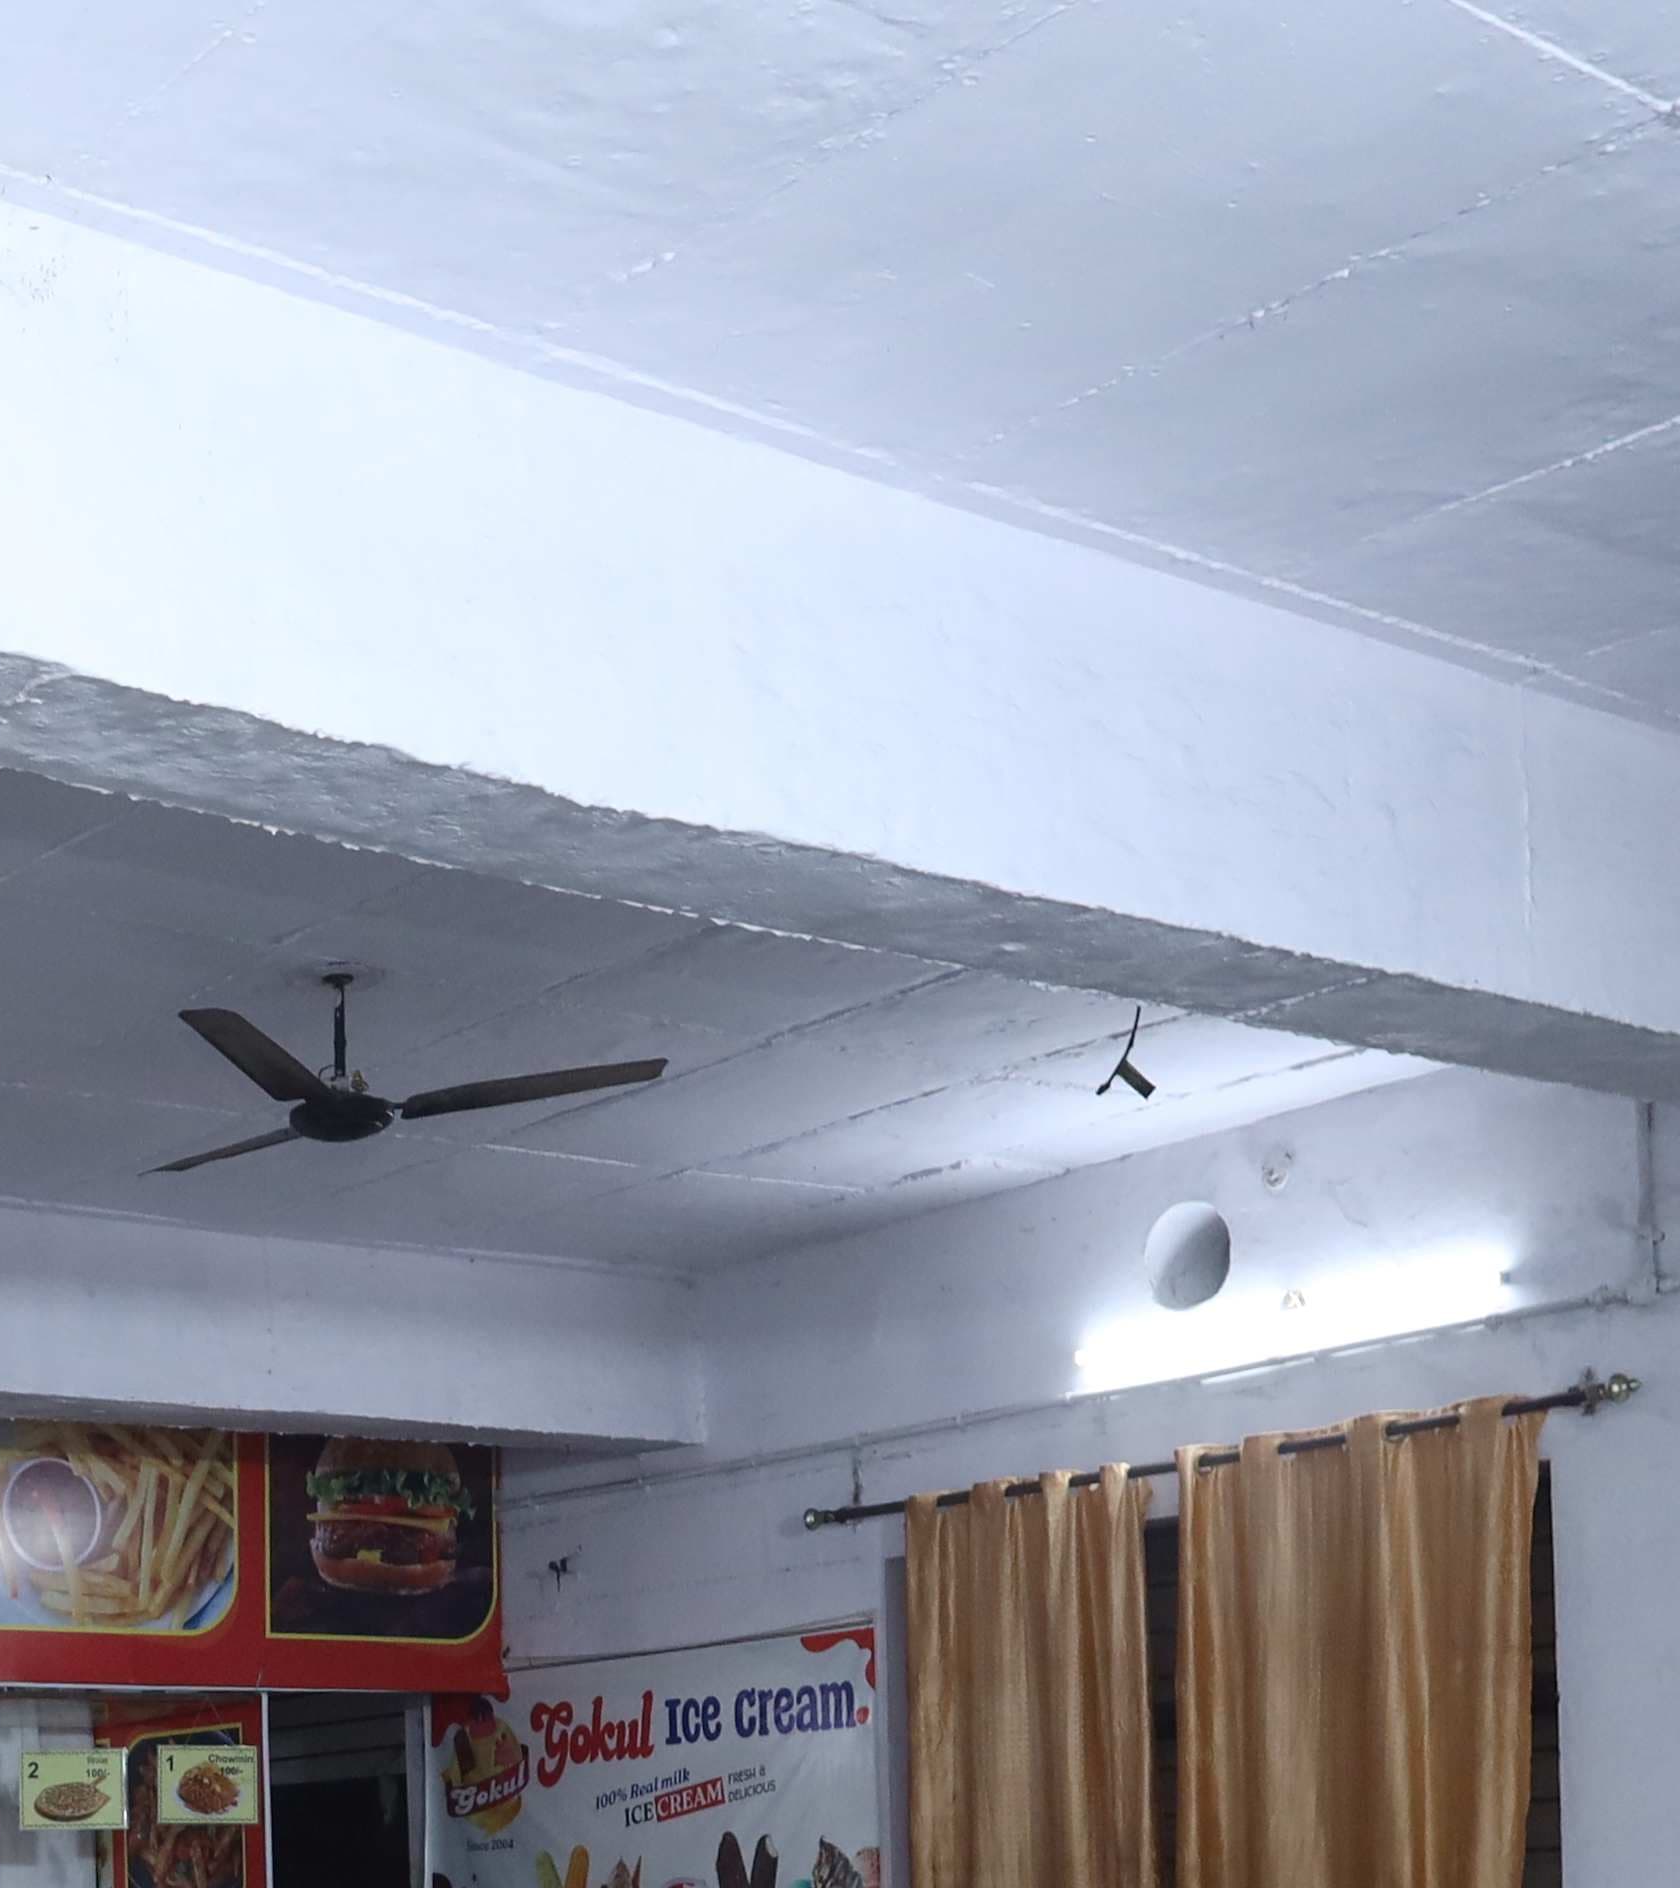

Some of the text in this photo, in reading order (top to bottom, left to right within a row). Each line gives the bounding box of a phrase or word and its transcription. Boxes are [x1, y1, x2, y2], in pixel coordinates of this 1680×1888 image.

[530, 1689, 655, 1788] Gokul
[27, 1761, 39, 1778] 2
[165, 1754, 175, 1772] 1
[727, 1769, 757, 1785] FRESH
[450, 1759, 526, 1815] Gokul
[595, 1767, 691, 1810] 100% Real milk
[727, 1779, 777, 1803] DELICIOUS
[624, 1781, 724, 1827] ICE CREAM
